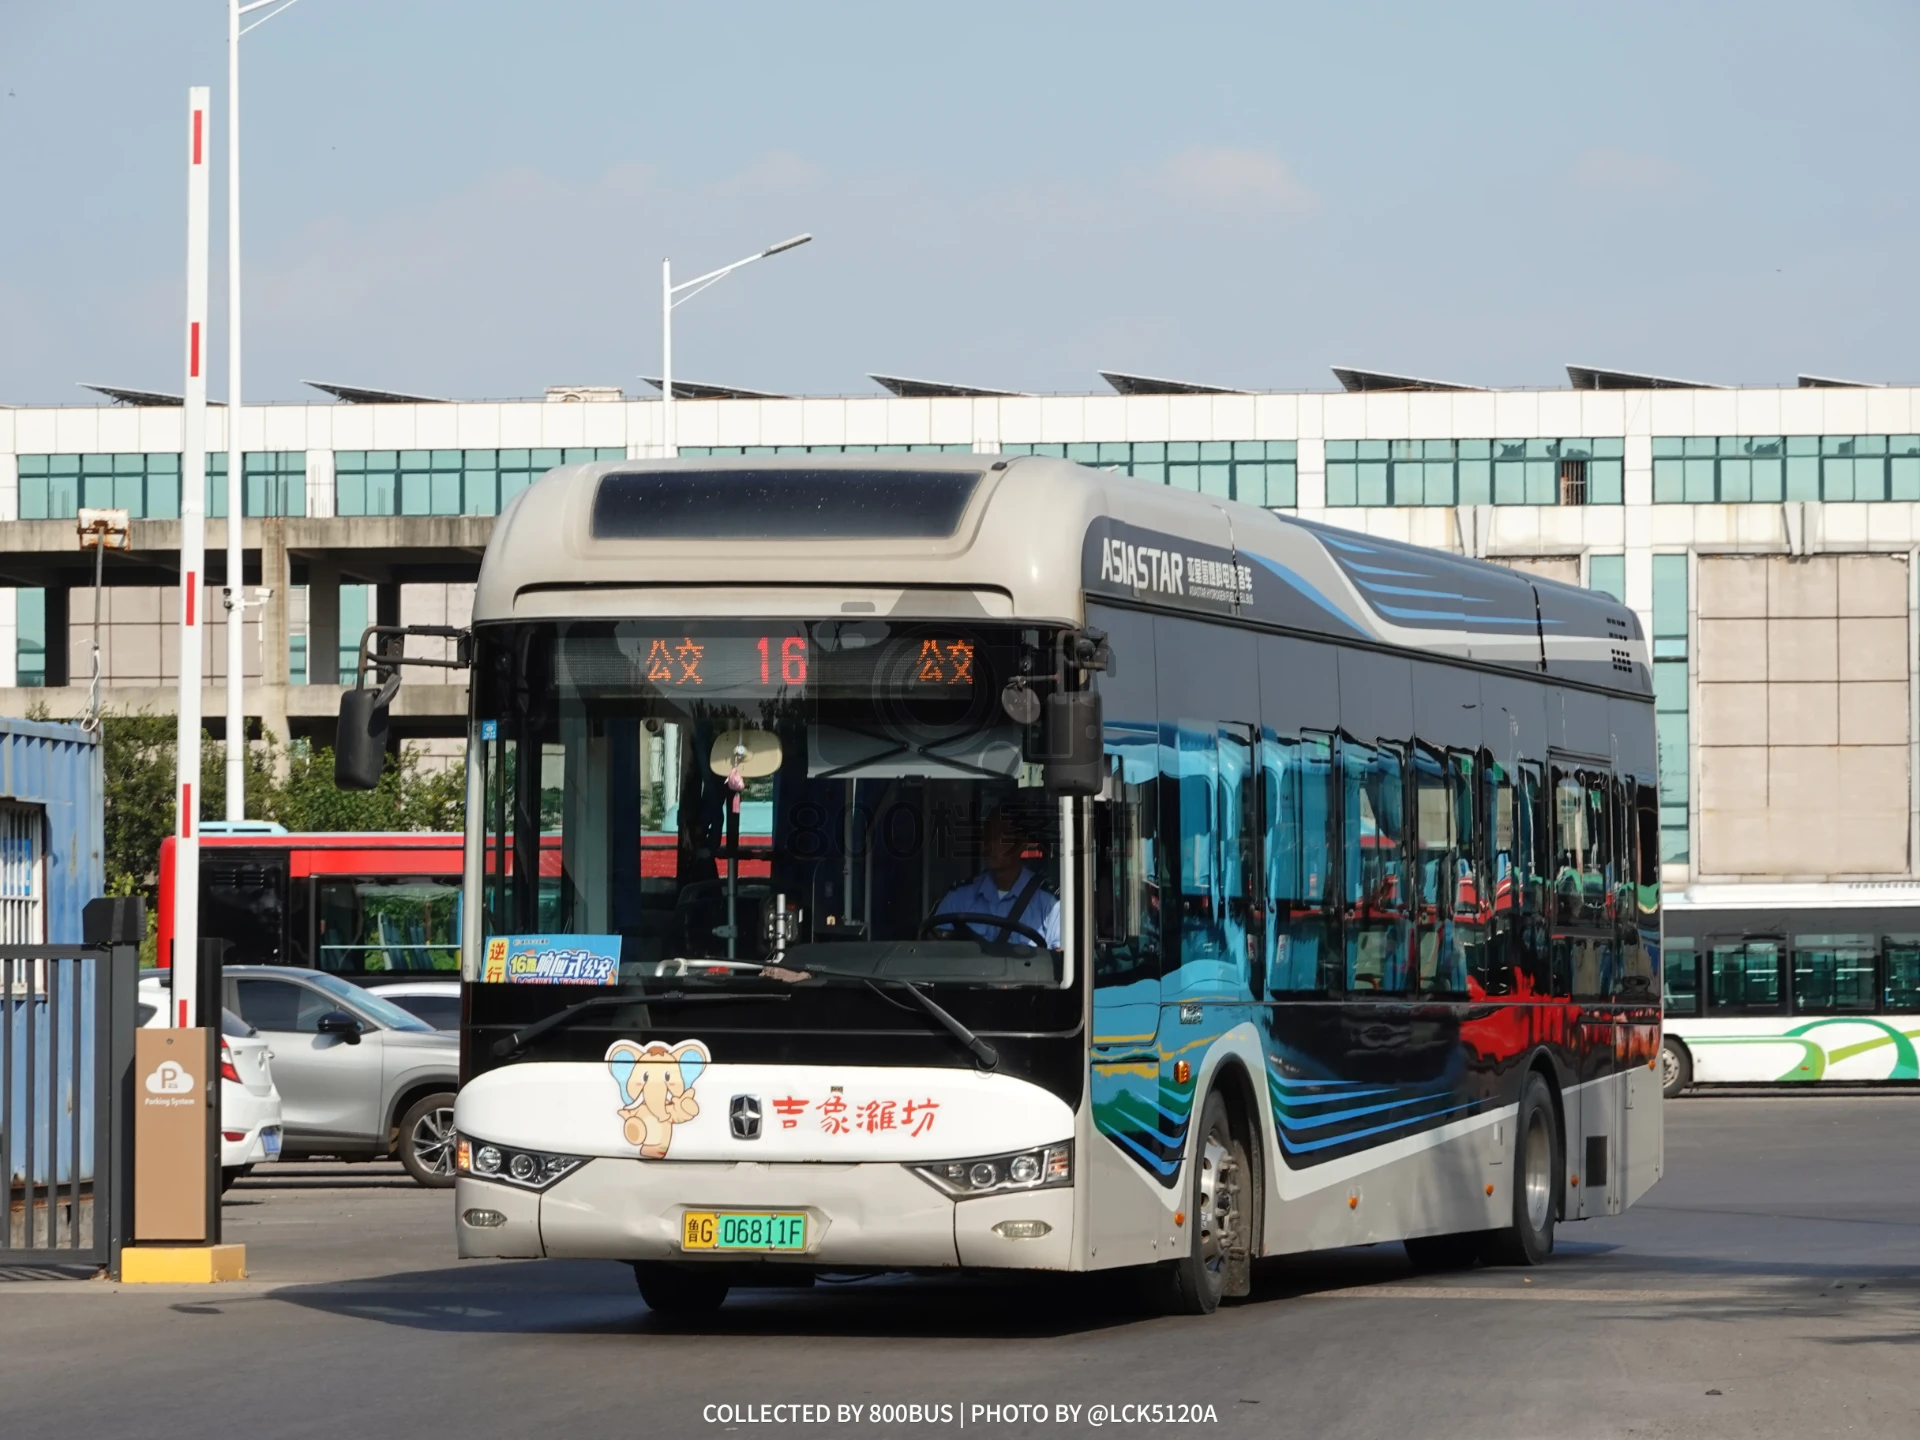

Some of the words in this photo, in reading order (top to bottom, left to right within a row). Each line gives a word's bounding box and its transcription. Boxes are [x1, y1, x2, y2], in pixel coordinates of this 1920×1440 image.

[1100, 537, 1184, 595] ASIASTAR
[647, 637, 704, 684] 公交
[757, 637, 807, 684] 16
[916, 639, 974, 684] 公交
[487, 943, 505, 983] 逆行
[145, 1097, 170, 1107] Parking
[171, 1097, 195, 1107] System
